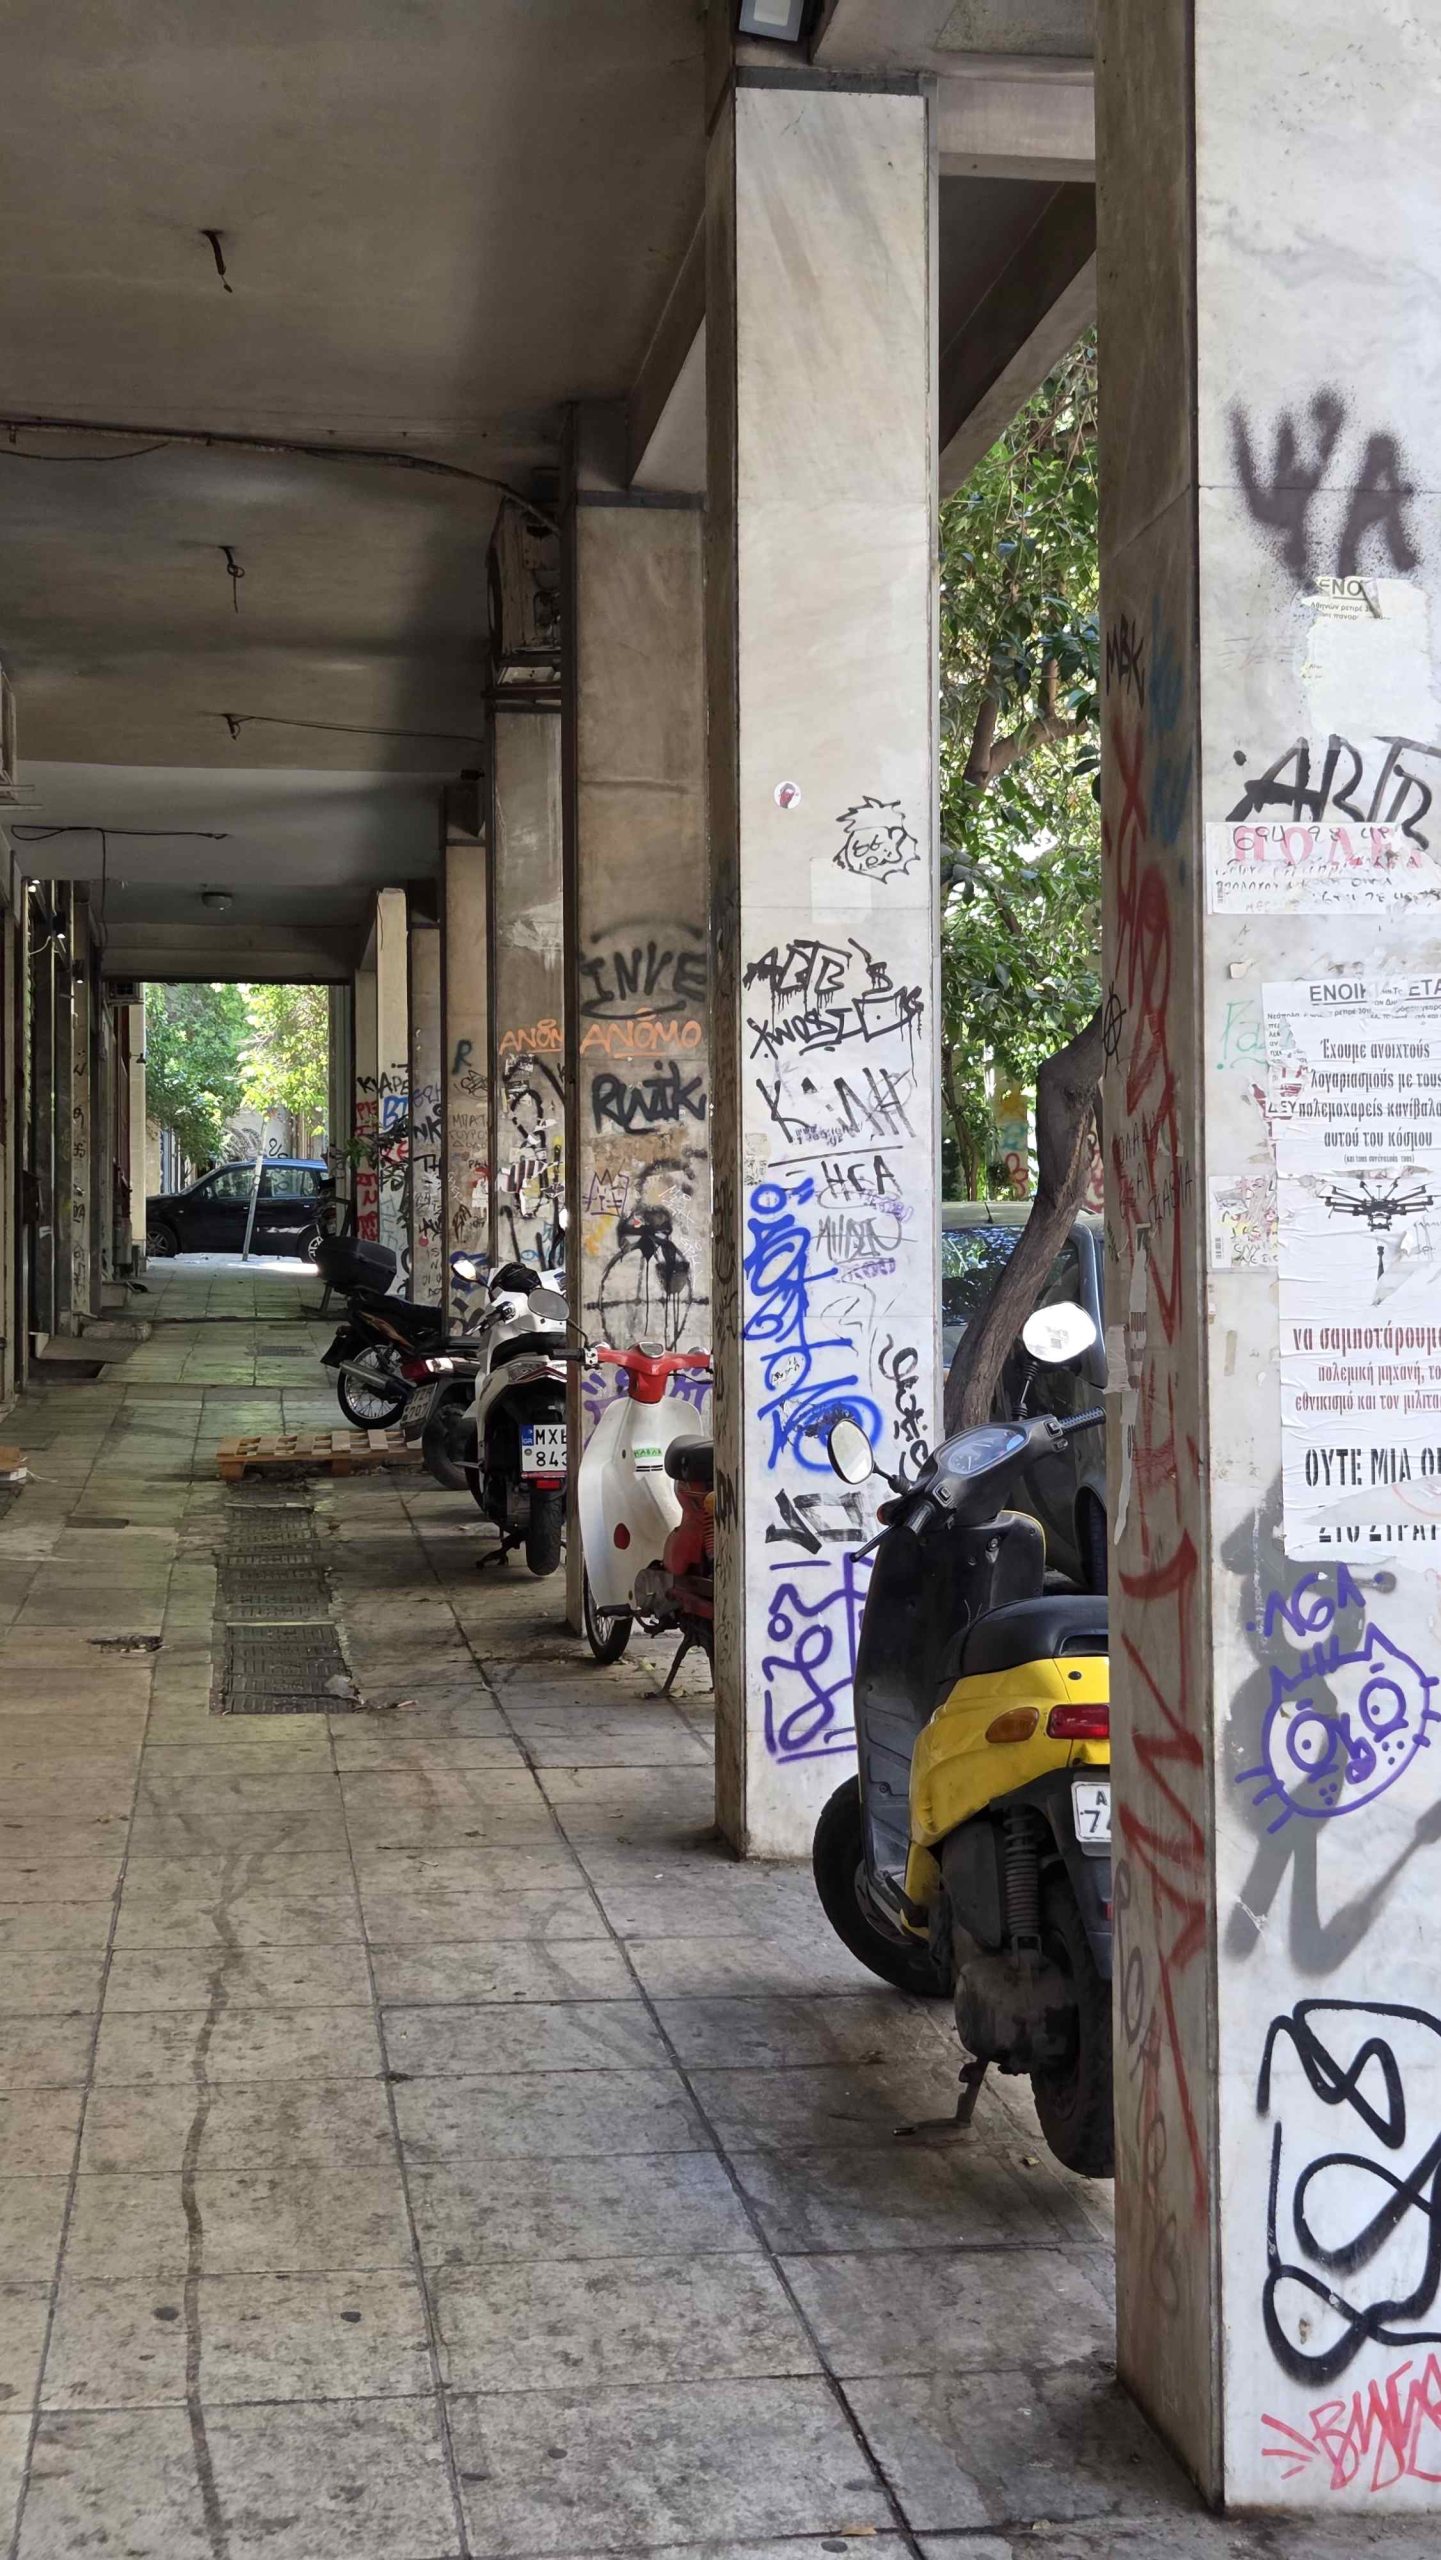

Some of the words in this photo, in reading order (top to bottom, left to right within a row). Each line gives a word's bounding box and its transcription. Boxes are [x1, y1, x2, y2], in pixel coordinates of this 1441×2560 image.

[1320, 1038, 1367, 1064] Έχουμε
[1370, 1038, 1430, 1060] ανοιχτούς
[1311, 1069, 1394, 1092] λογαριασμούς
[1399, 1074, 1412, 1093] με
[1298, 1100, 1383, 1122] πολεμοχαρείς
[1324, 1127, 1359, 1148] αυτού
[1362, 1132, 1384, 1148] του
[1388, 1127, 1432, 1151] κόσμου
[1293, 1328, 1313, 1351] να
[1318, 1361, 1374, 1386] πολεμική
[1378, 1361, 1425, 1386] μηχανή,
[1296, 1391, 1354, 1415] εθνικισμό
[1357, 1395, 1377, 1410] και
[1379, 1394, 1400, 1410] τον
[1305, 1448, 1363, 1487] ΟΥΤΕ
[1370, 1447, 1412, 1486] ΜΙΑ
